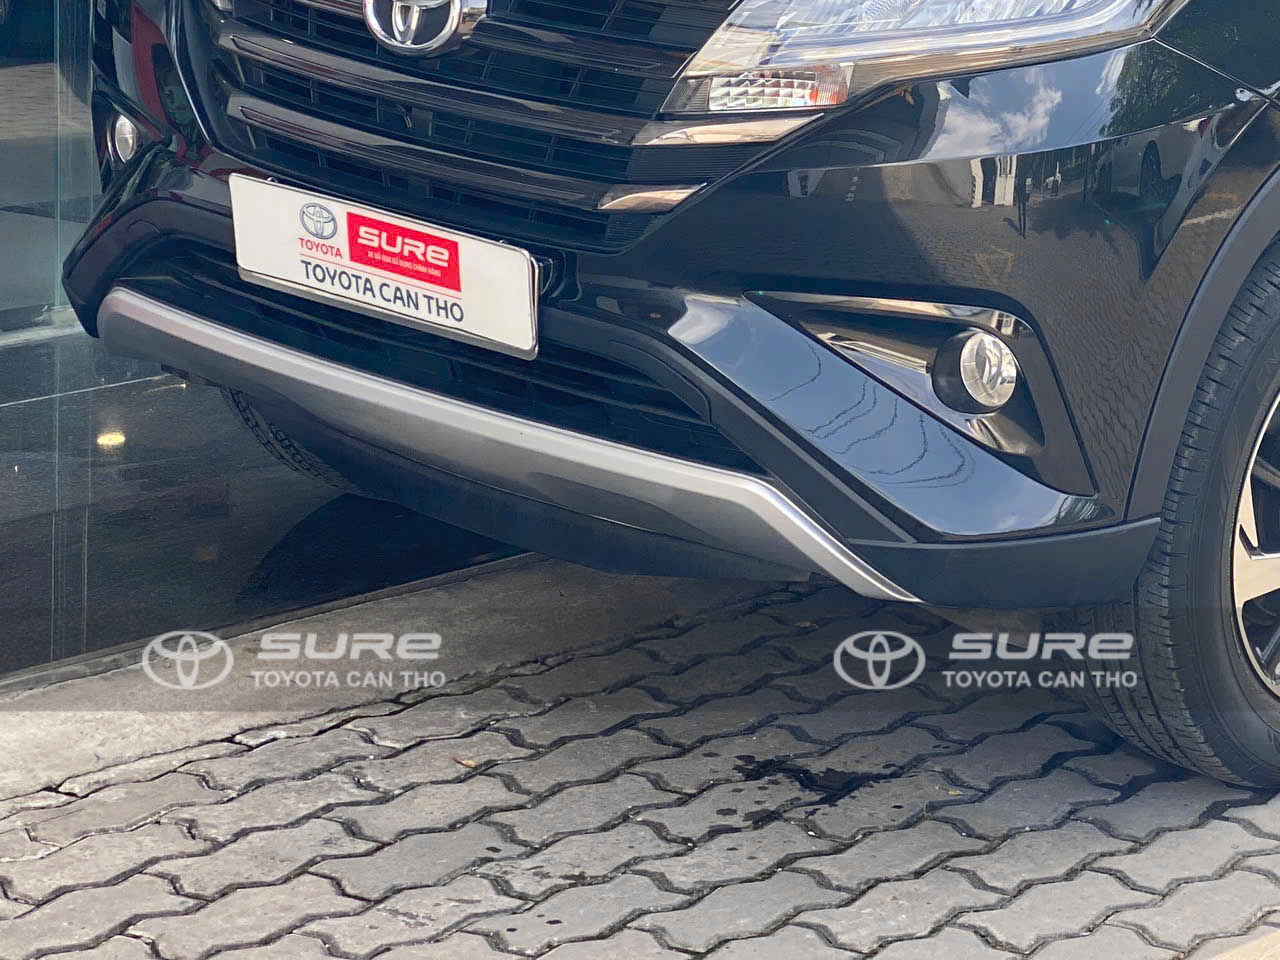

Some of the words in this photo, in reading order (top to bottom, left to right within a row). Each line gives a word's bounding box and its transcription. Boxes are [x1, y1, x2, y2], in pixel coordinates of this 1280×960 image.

[298, 237, 343, 260] TOYOTA
[301, 259, 376, 299] TOYOTA
[378, 282, 419, 311] CAN
[422, 294, 465, 323] THO
